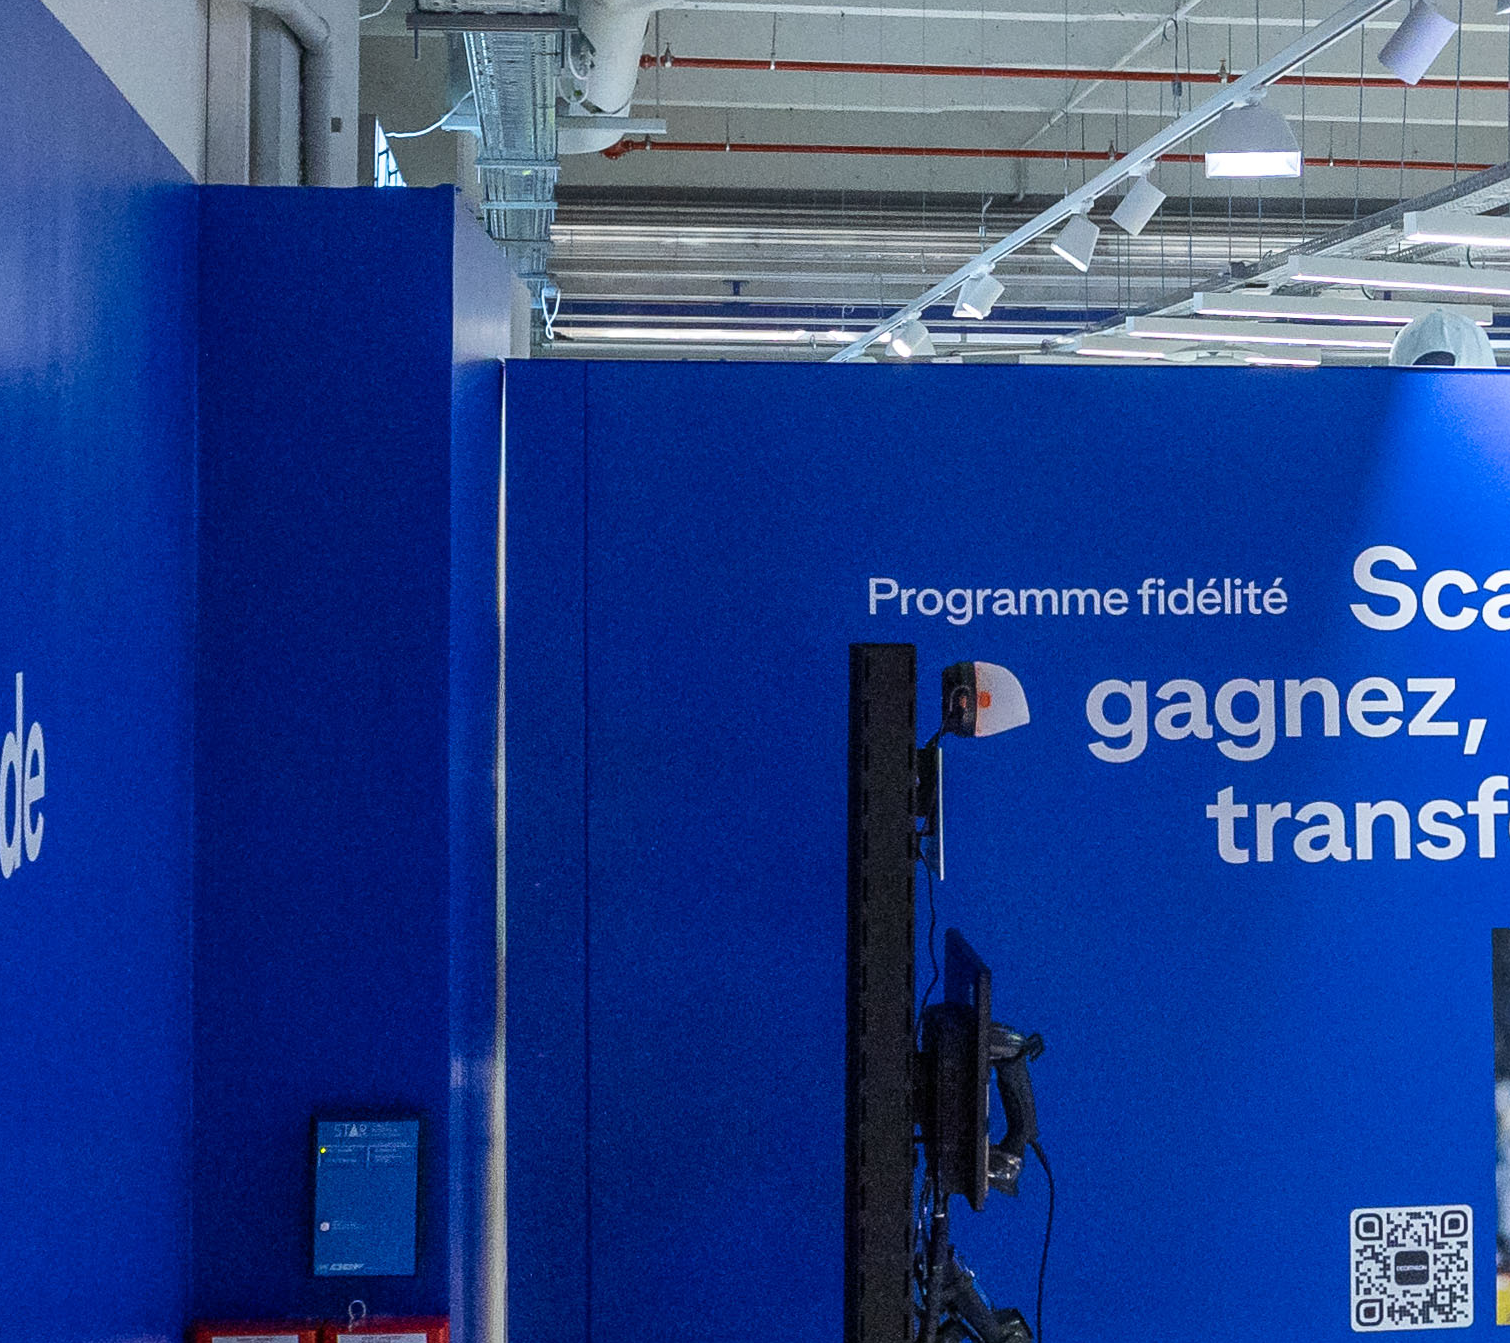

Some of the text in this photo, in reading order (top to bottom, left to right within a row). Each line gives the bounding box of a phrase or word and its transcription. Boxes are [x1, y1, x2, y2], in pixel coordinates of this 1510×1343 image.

[869, 578, 1287, 625] Programme fidélité
[1086, 677, 1487, 763] gagnez,
